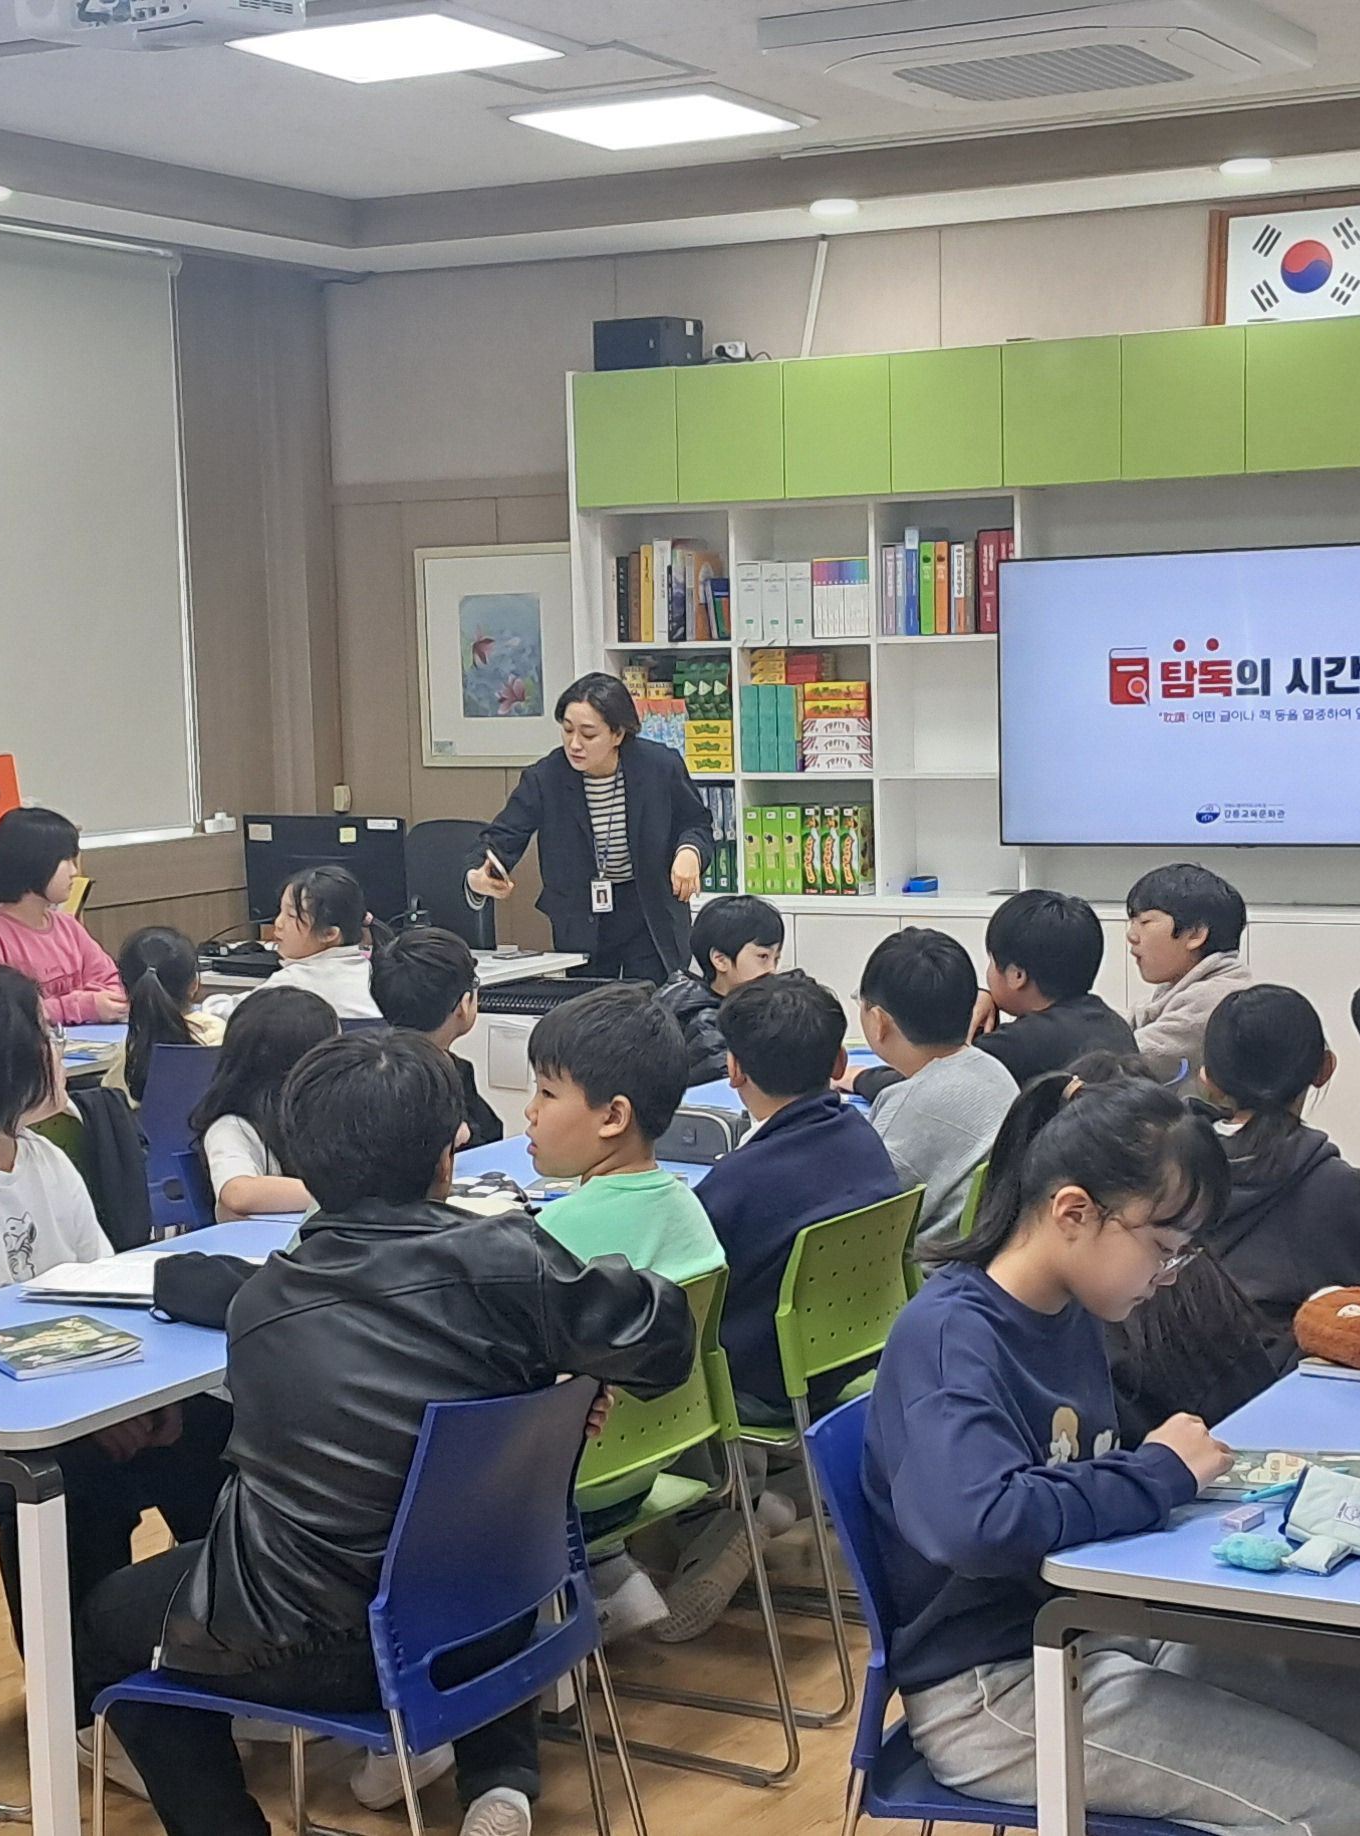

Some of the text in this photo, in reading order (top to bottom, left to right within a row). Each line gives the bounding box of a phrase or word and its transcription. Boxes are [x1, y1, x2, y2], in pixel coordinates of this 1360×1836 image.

[1160, 658, 1271, 698] 탐독의
[1192, 709, 1216, 722] 어떤
[1219, 709, 1254, 722] 글이나
